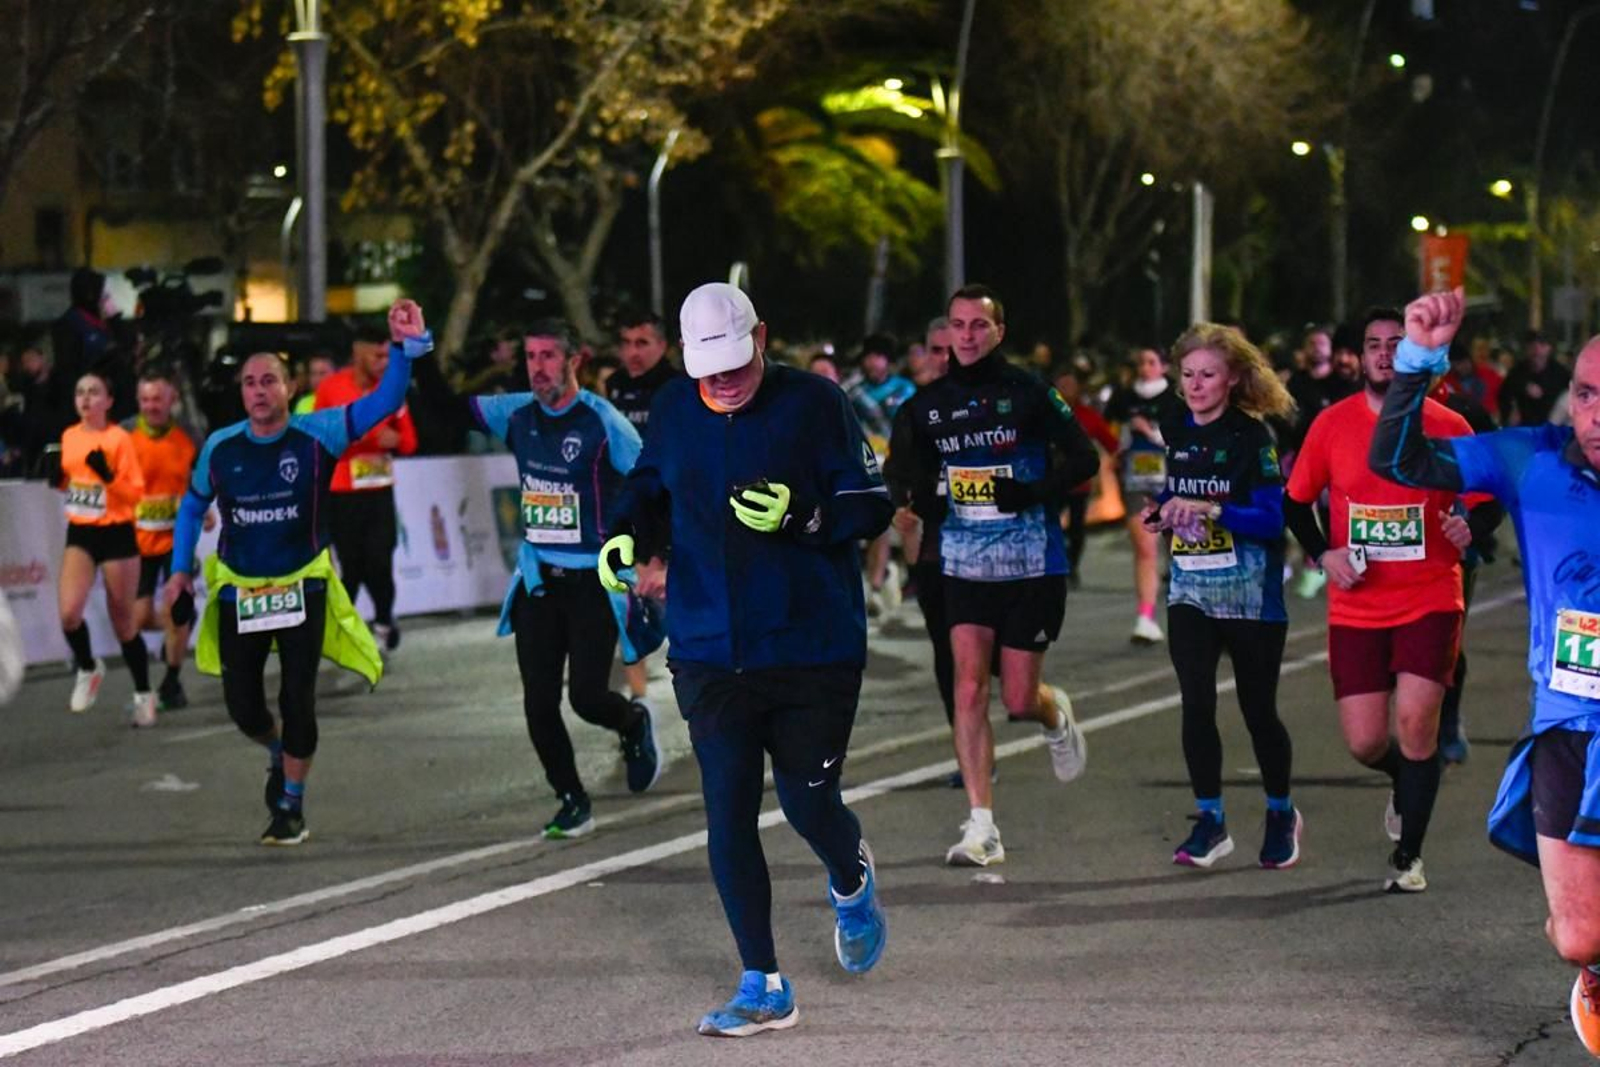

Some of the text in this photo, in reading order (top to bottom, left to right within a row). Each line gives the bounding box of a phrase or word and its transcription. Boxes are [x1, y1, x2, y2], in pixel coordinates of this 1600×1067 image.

[964, 425, 1017, 448] ANTÓN
[1178, 475, 1230, 495] ANTÓN
[524, 505, 574, 525] 1148
[1356, 520, 1418, 541] 1434
[243, 592, 298, 615] 1159
